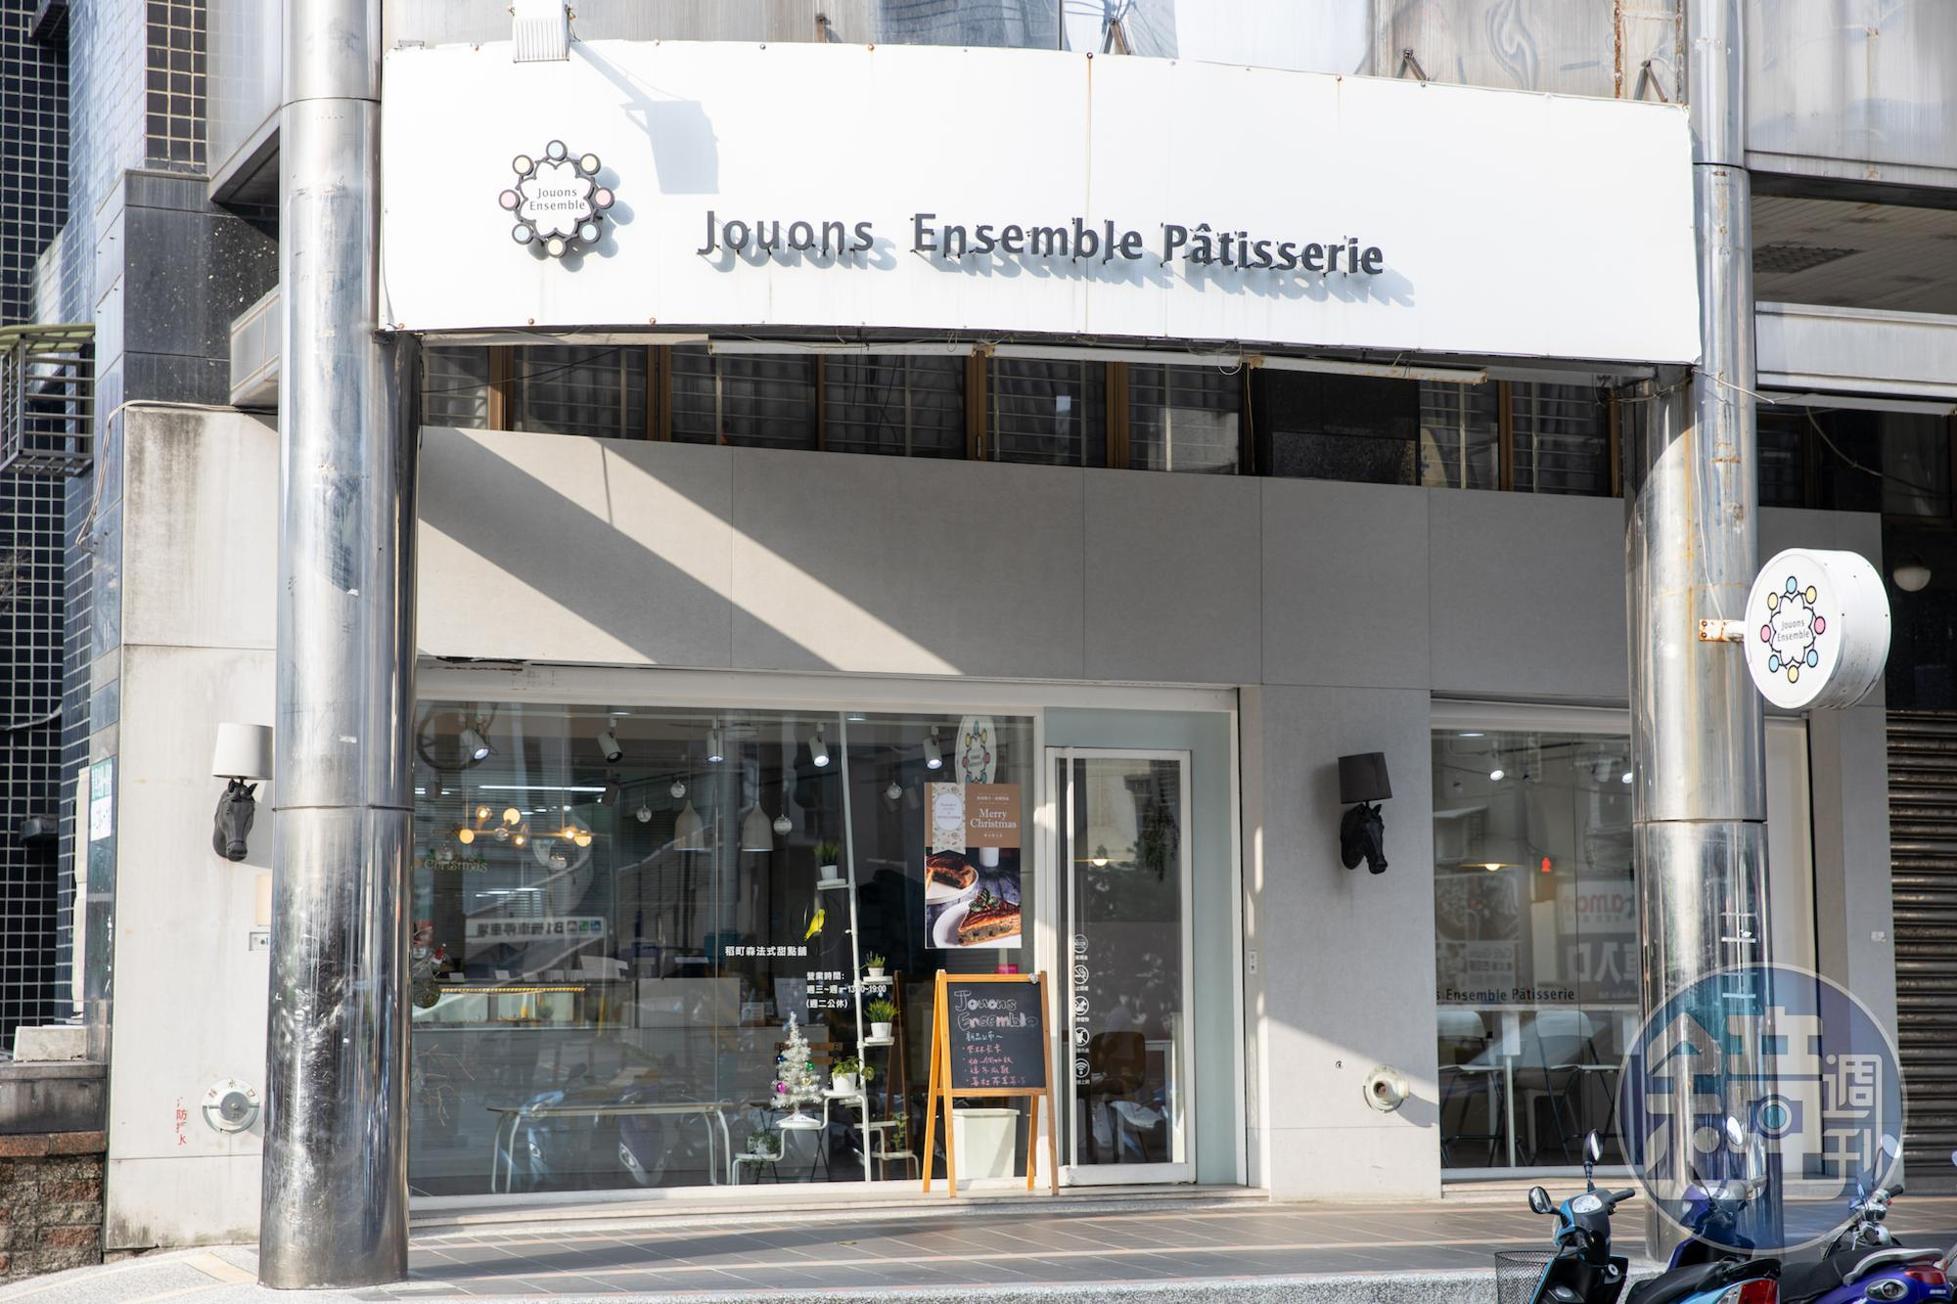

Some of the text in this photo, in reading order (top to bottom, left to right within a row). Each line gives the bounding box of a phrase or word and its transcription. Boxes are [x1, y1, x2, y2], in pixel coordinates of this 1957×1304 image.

[537, 188, 577, 199] Jouons
[529, 200, 585, 211] Ensemble
[697, 210, 1384, 275] Jouons Ensemble Pâtisserie
[1781, 619, 1804, 631] Jouons
[1777, 630, 1809, 642] Ensemble
[978, 808, 1008, 820] Merry
[970, 818, 1017, 829] Christmas
[1446, 988, 1507, 1001] Ensemble
[1511, 987, 1575, 1001] Pâtisserie
[954, 989, 1017, 1012] Jouons
[957, 1011, 1039, 1031] Ensemble
